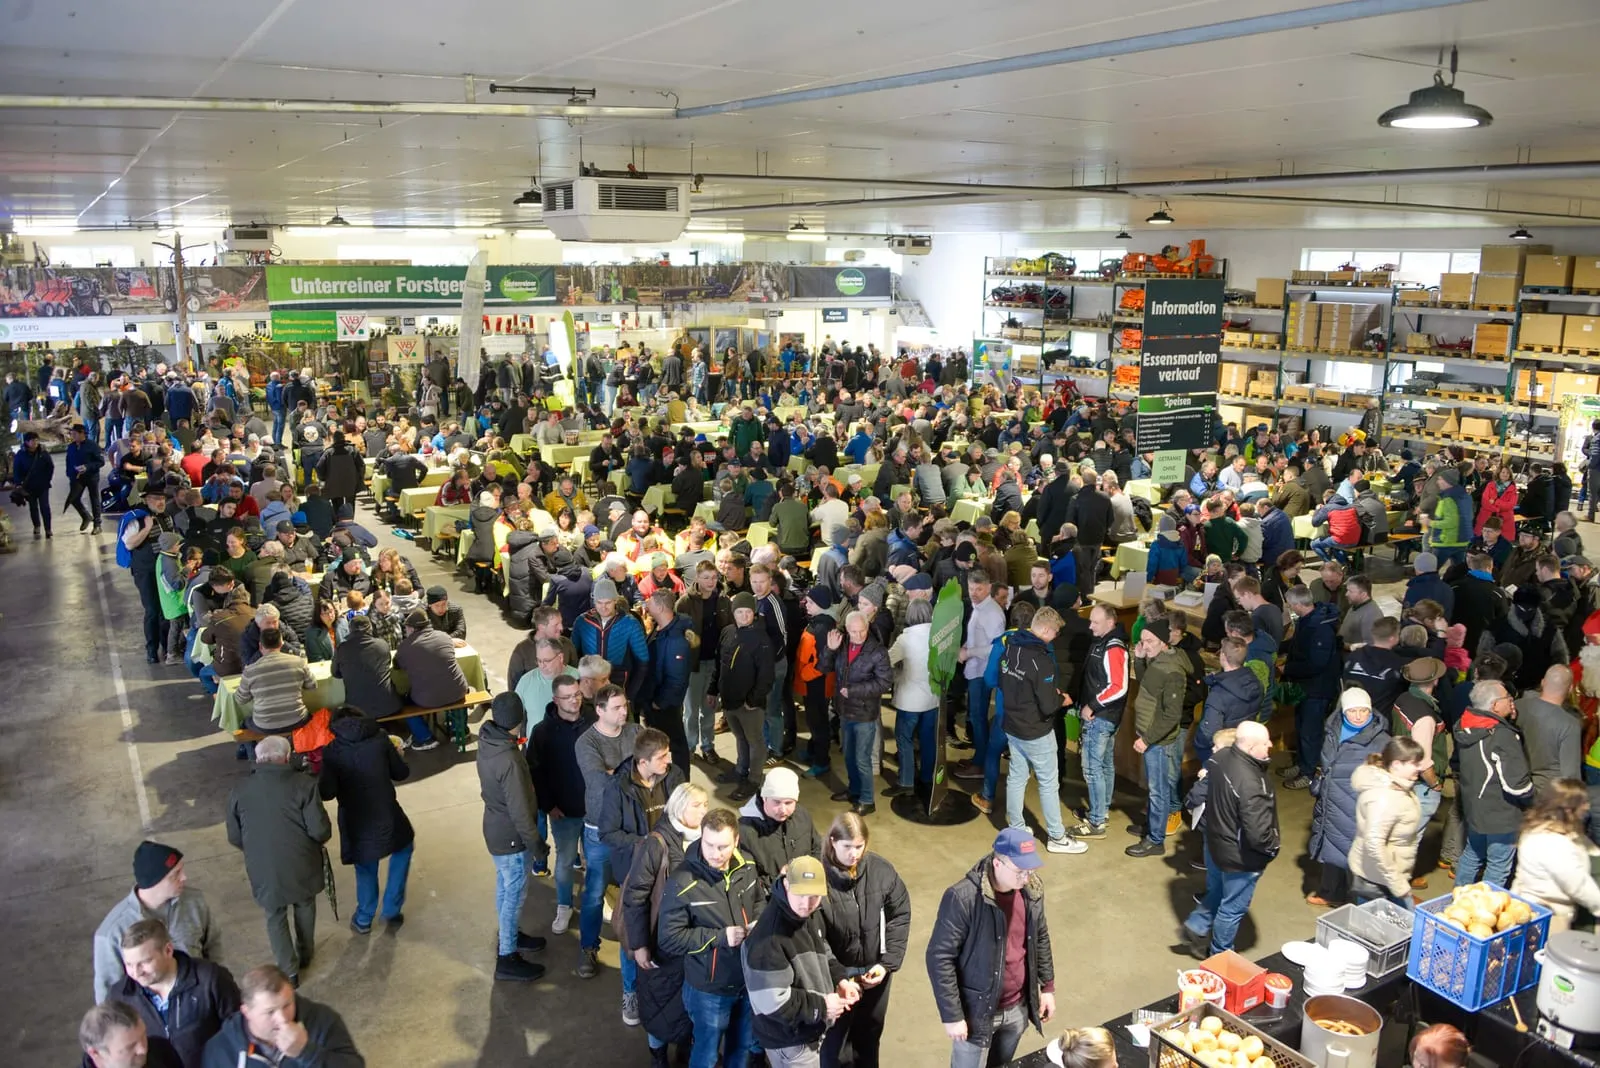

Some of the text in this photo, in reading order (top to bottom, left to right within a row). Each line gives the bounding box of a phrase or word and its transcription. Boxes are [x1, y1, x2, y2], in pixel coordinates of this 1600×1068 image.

[291, 277, 391, 294] Unterreiner
[1151, 301, 1216, 315] Information
[1143, 351, 1217, 366] Essensmarken
[1159, 366, 1200, 381] verkauf
[1164, 397, 1191, 408] Speisen
